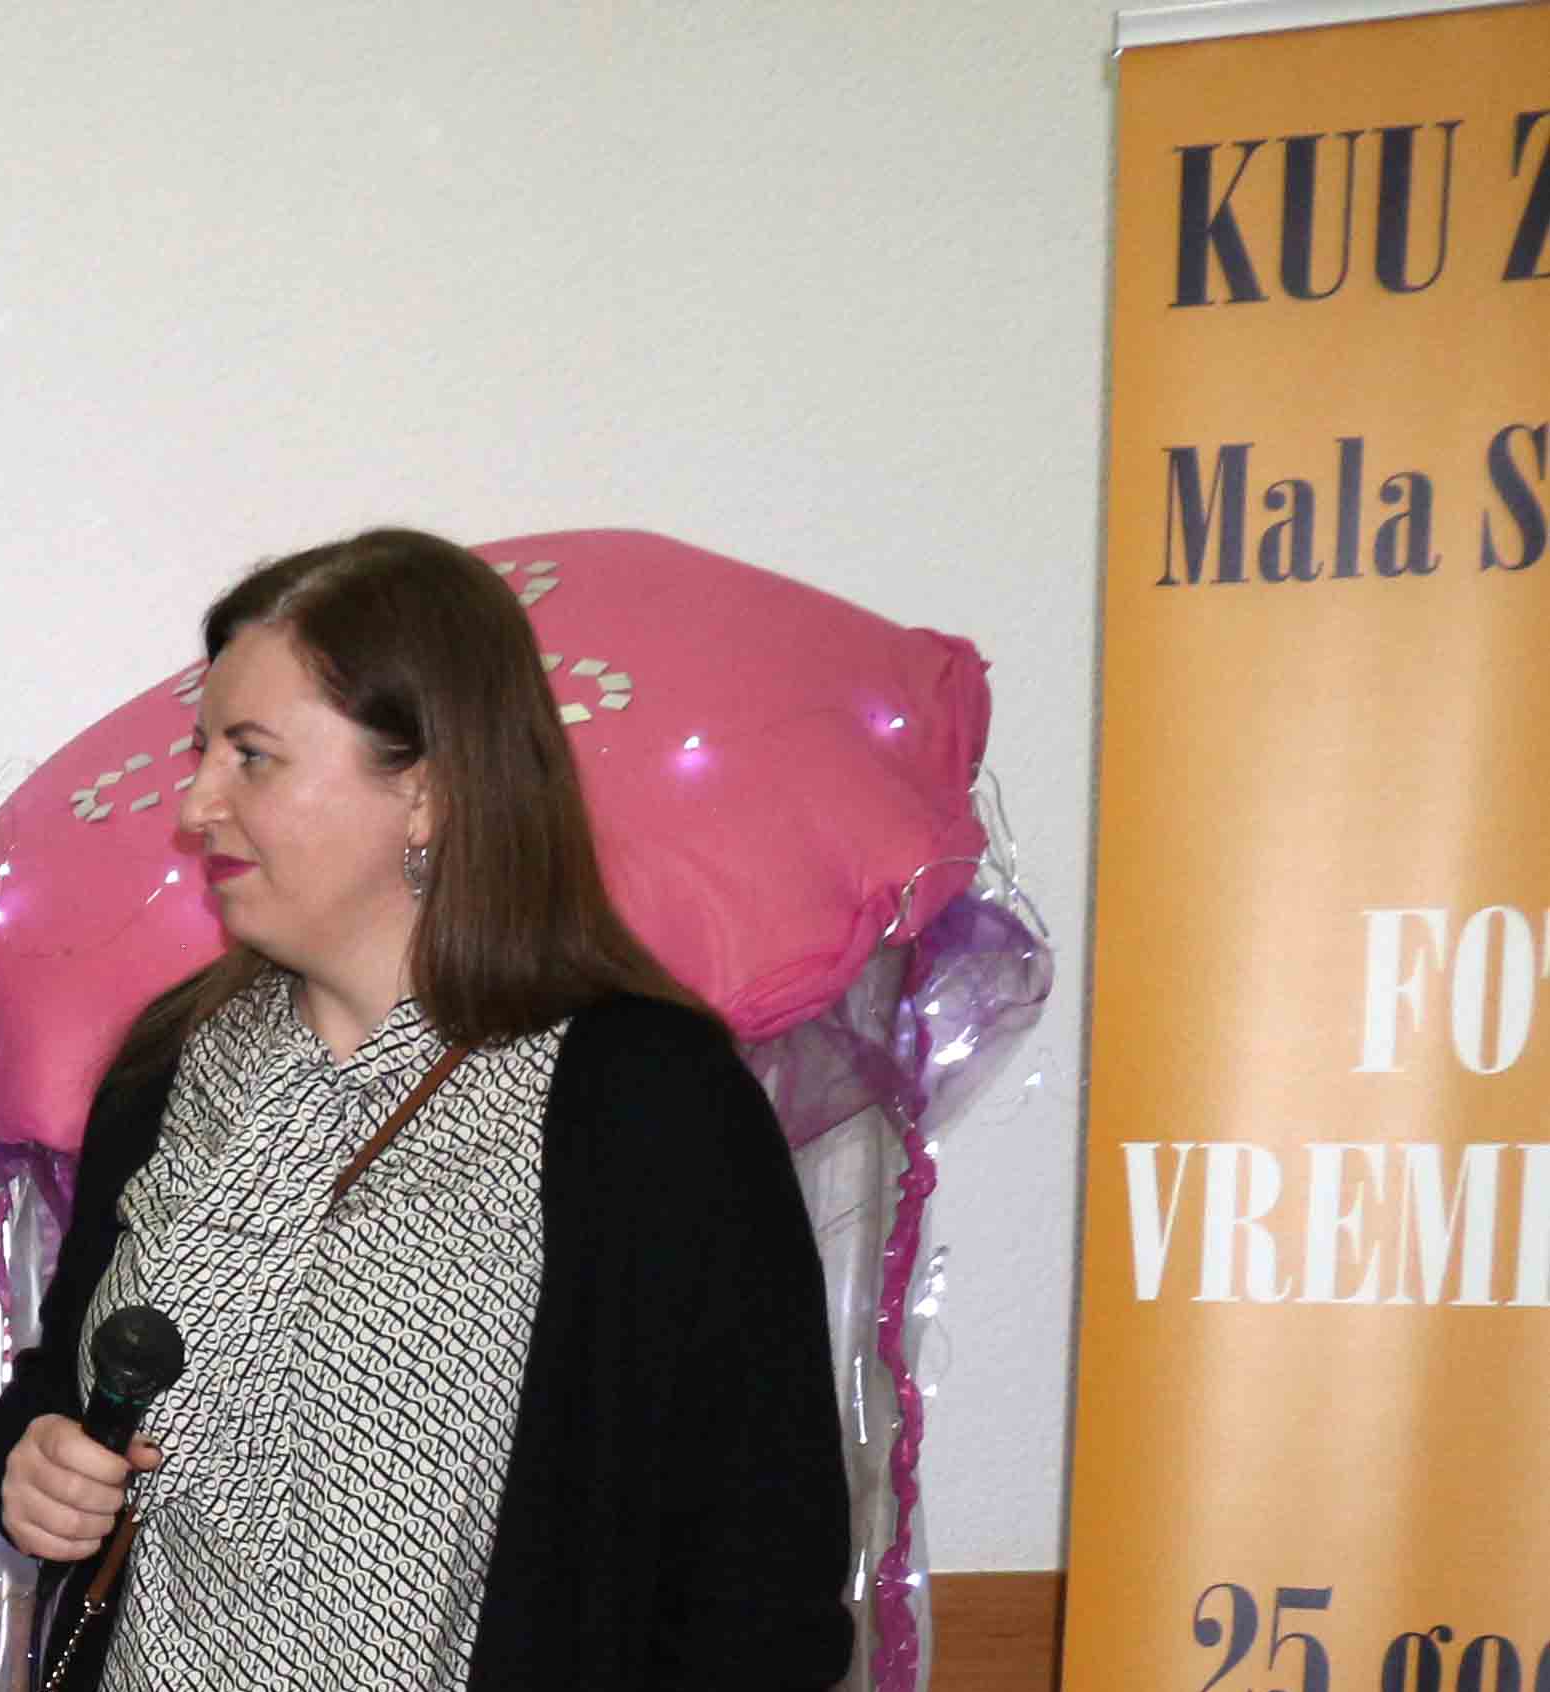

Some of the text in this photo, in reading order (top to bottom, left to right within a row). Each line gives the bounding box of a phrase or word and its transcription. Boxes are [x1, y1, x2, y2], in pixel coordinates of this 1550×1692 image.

[1169, 119, 1465, 308] KUU
[1155, 436, 1441, 587] Mala
[1351, 905, 1550, 1075] FO
